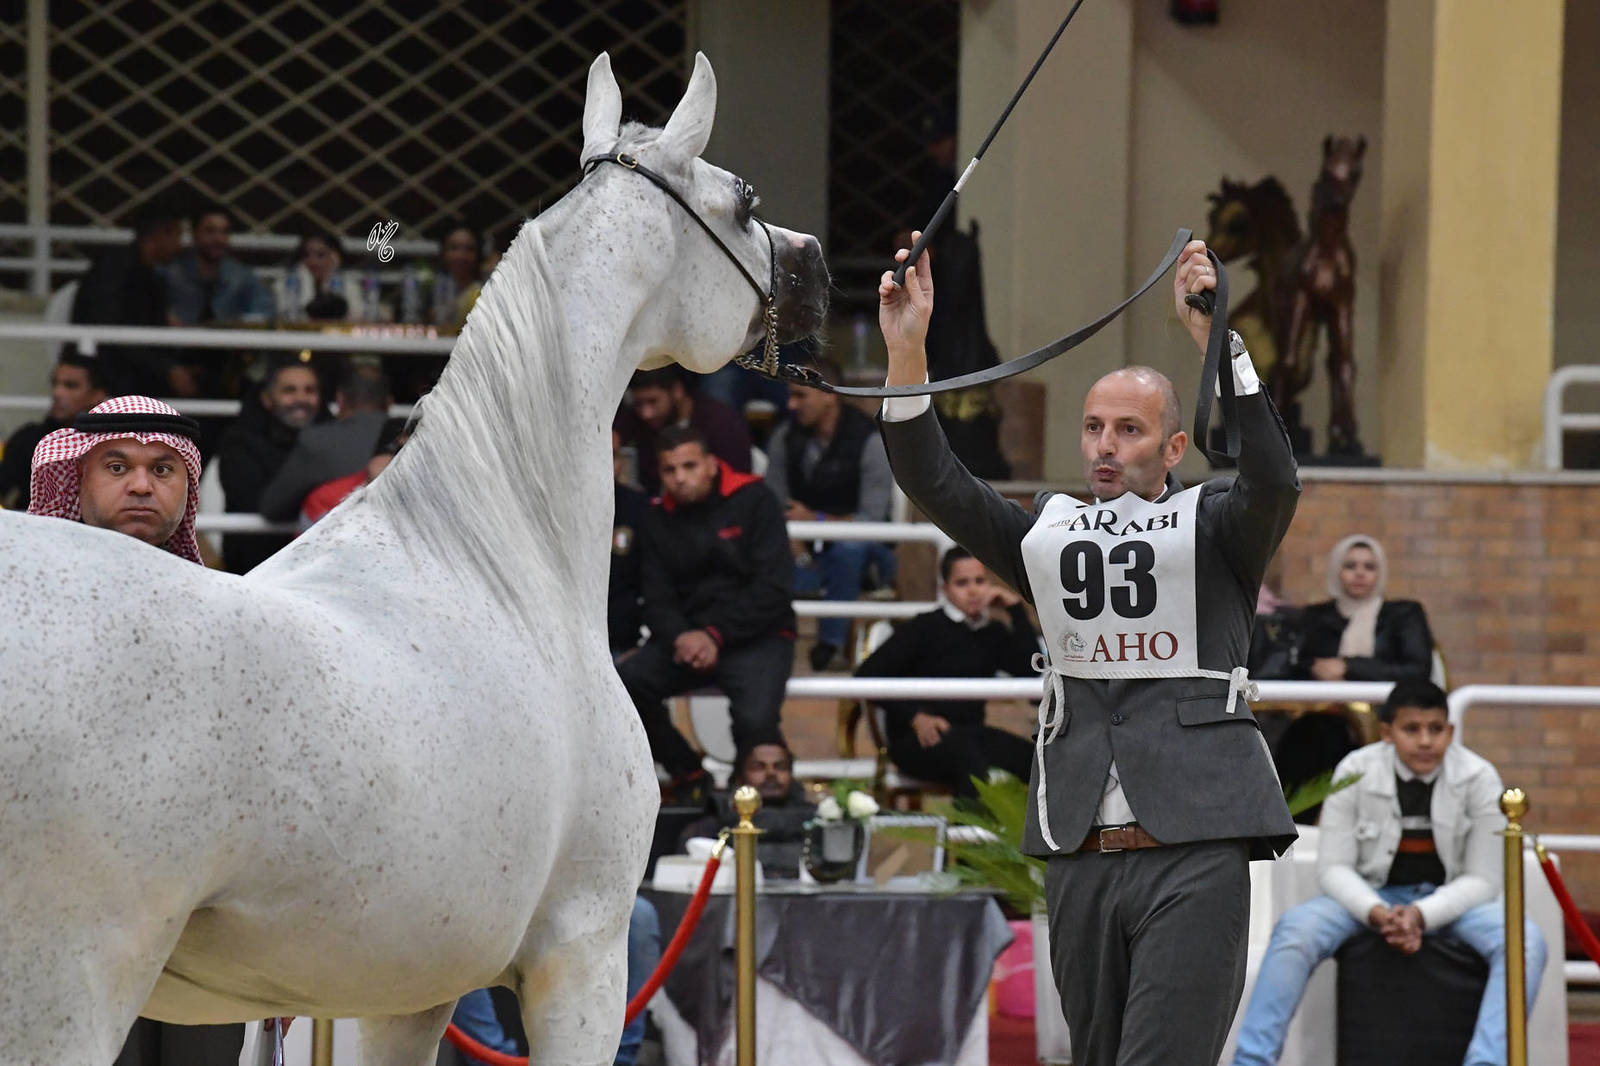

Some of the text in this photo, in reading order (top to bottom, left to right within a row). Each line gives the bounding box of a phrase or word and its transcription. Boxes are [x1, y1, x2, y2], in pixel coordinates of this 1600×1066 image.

[1069, 510, 1178, 537] ARABI
[1060, 540, 1158, 620] 93
[1090, 631, 1179, 663] AHO
